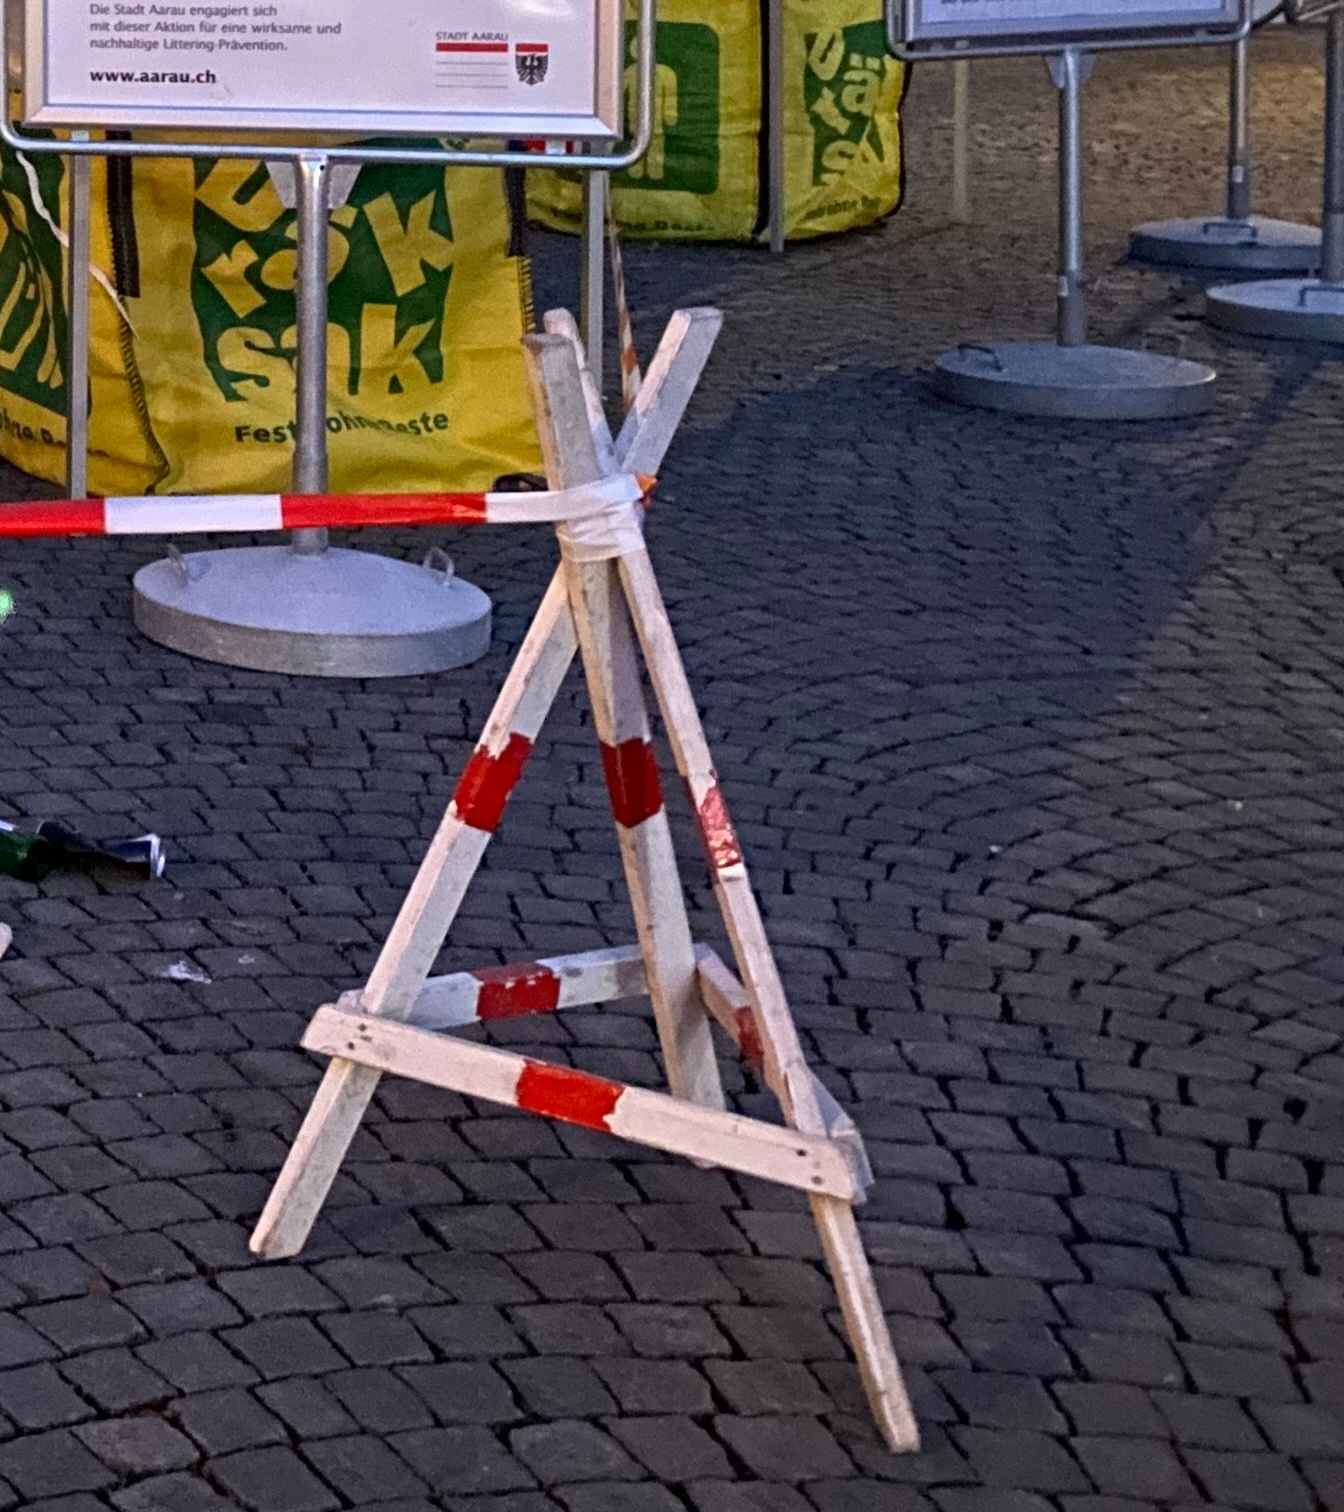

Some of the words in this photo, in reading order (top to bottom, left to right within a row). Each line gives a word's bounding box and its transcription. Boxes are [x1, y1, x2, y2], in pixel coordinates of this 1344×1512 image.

[89, 3, 111, 16] Die
[113, 3, 145, 16] Stadt
[148, 3, 186, 17] Aarau
[189, 4, 248, 18] engagiert
[252, 4, 278, 17] sich
[89, 21, 111, 33] mit
[113, 21, 151, 33] dieser
[153, 21, 196, 33] Aktion
[198, 21, 218, 34] für
[220, 22, 248, 34] eine
[251, 22, 313, 35] wirksame
[316, 22, 342, 35] und
[435, 31, 469, 41] STADT
[471, 32, 509, 42] AARAU
[89, 38, 160, 52] nachhaltige
[89, 69, 217, 84] www.aarau.ch
[234, 418, 302, 444] Fest
